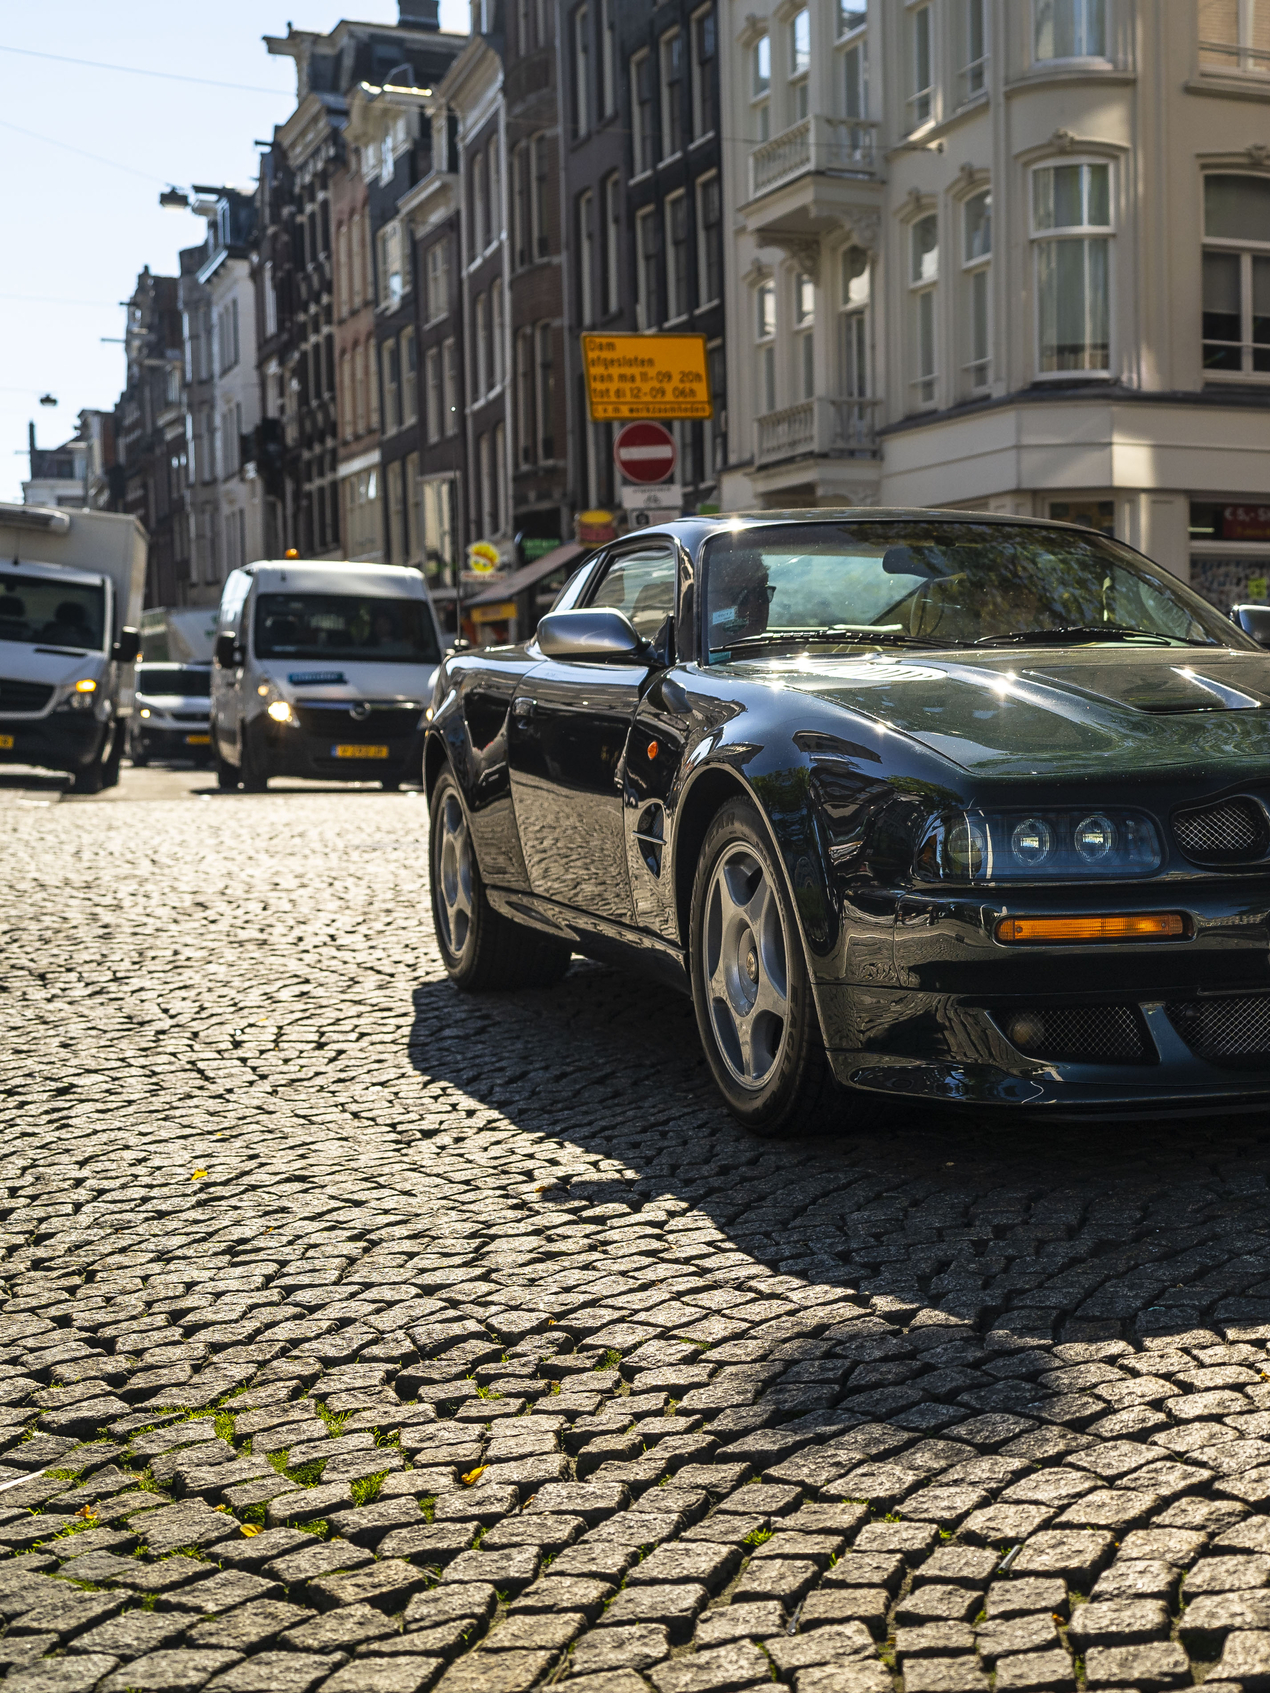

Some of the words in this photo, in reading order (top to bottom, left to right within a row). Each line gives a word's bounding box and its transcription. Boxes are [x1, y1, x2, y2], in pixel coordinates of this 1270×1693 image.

[587, 338, 616, 352] Dam
[589, 355, 655, 370] afgesloten
[591, 373, 614, 383] van
[617, 373, 636, 383] ma
[678, 370, 703, 383] 20h
[591, 387, 611, 399] tot
[614, 386, 626, 399] di
[629, 386, 667, 399] 12-09
[777, 982, 799, 1085] EAGLE
